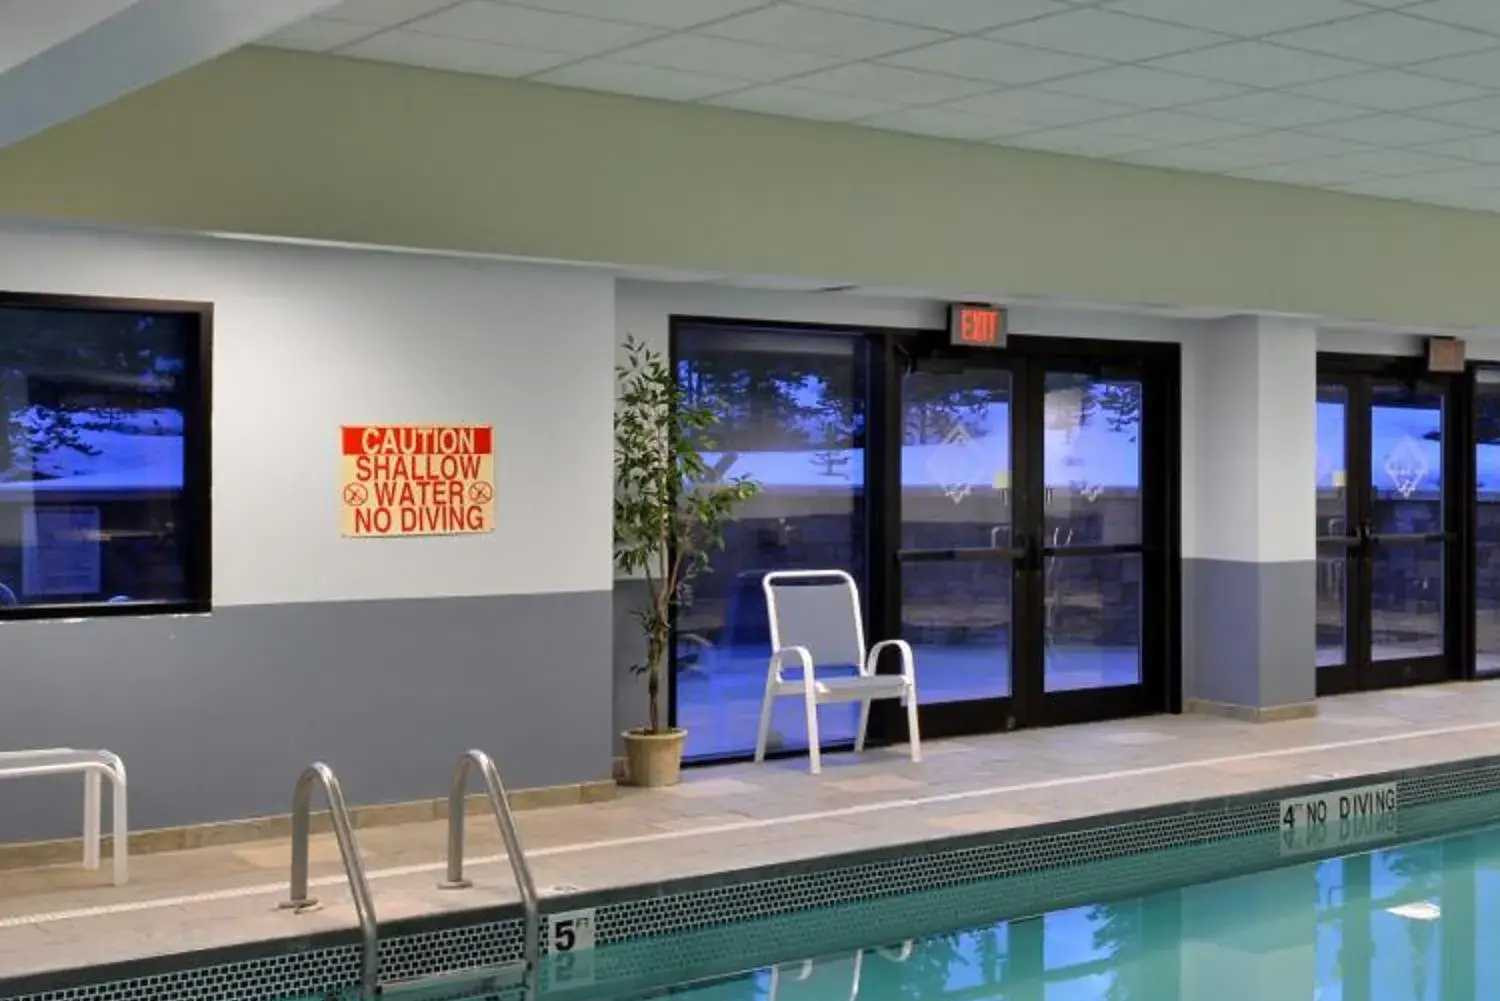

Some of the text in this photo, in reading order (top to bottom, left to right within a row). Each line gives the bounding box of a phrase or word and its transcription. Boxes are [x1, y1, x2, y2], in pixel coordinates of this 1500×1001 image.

[361, 427, 475, 453] CAUTION
[356, 455, 481, 481] SHALLOW
[374, 481, 464, 506] WATER
[355, 505, 483, 533] NO DIVING
[1283, 788, 1395, 828] 4 NO DIVING
[555, 919, 575, 951] 5
